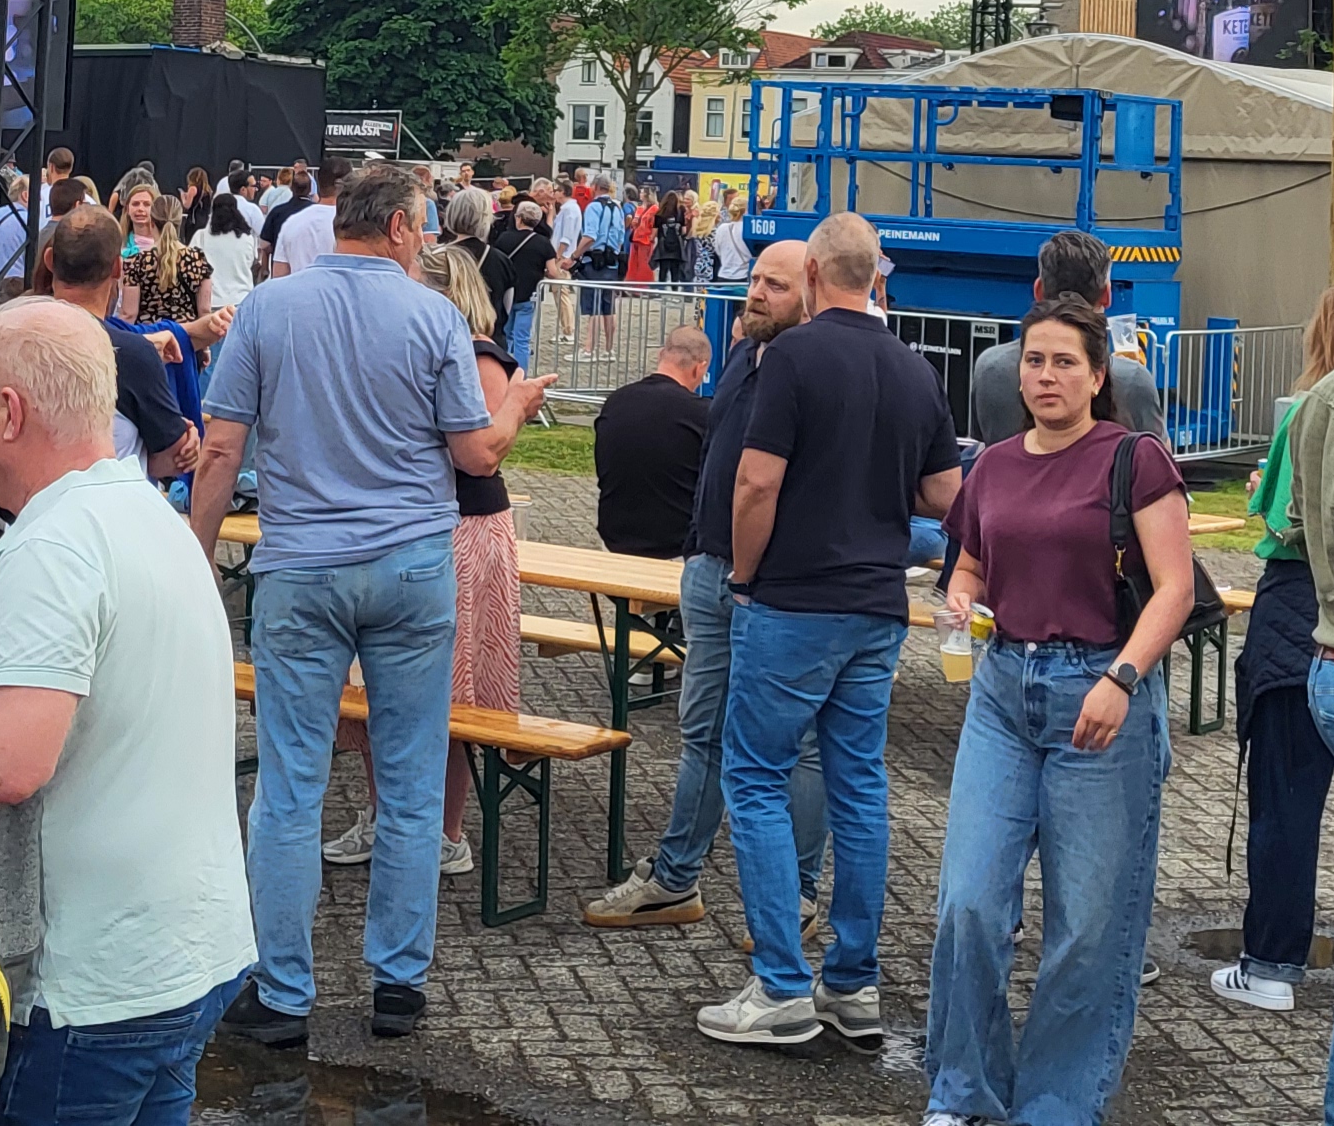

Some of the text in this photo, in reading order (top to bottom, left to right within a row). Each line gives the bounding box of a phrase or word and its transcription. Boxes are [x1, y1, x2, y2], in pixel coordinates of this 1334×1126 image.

[326, 124, 381, 136] TENKASSA
[750, 219, 776, 235] 1608
[878, 229, 941, 242] PEINEMANN
[974, 325, 996, 335] MSR
